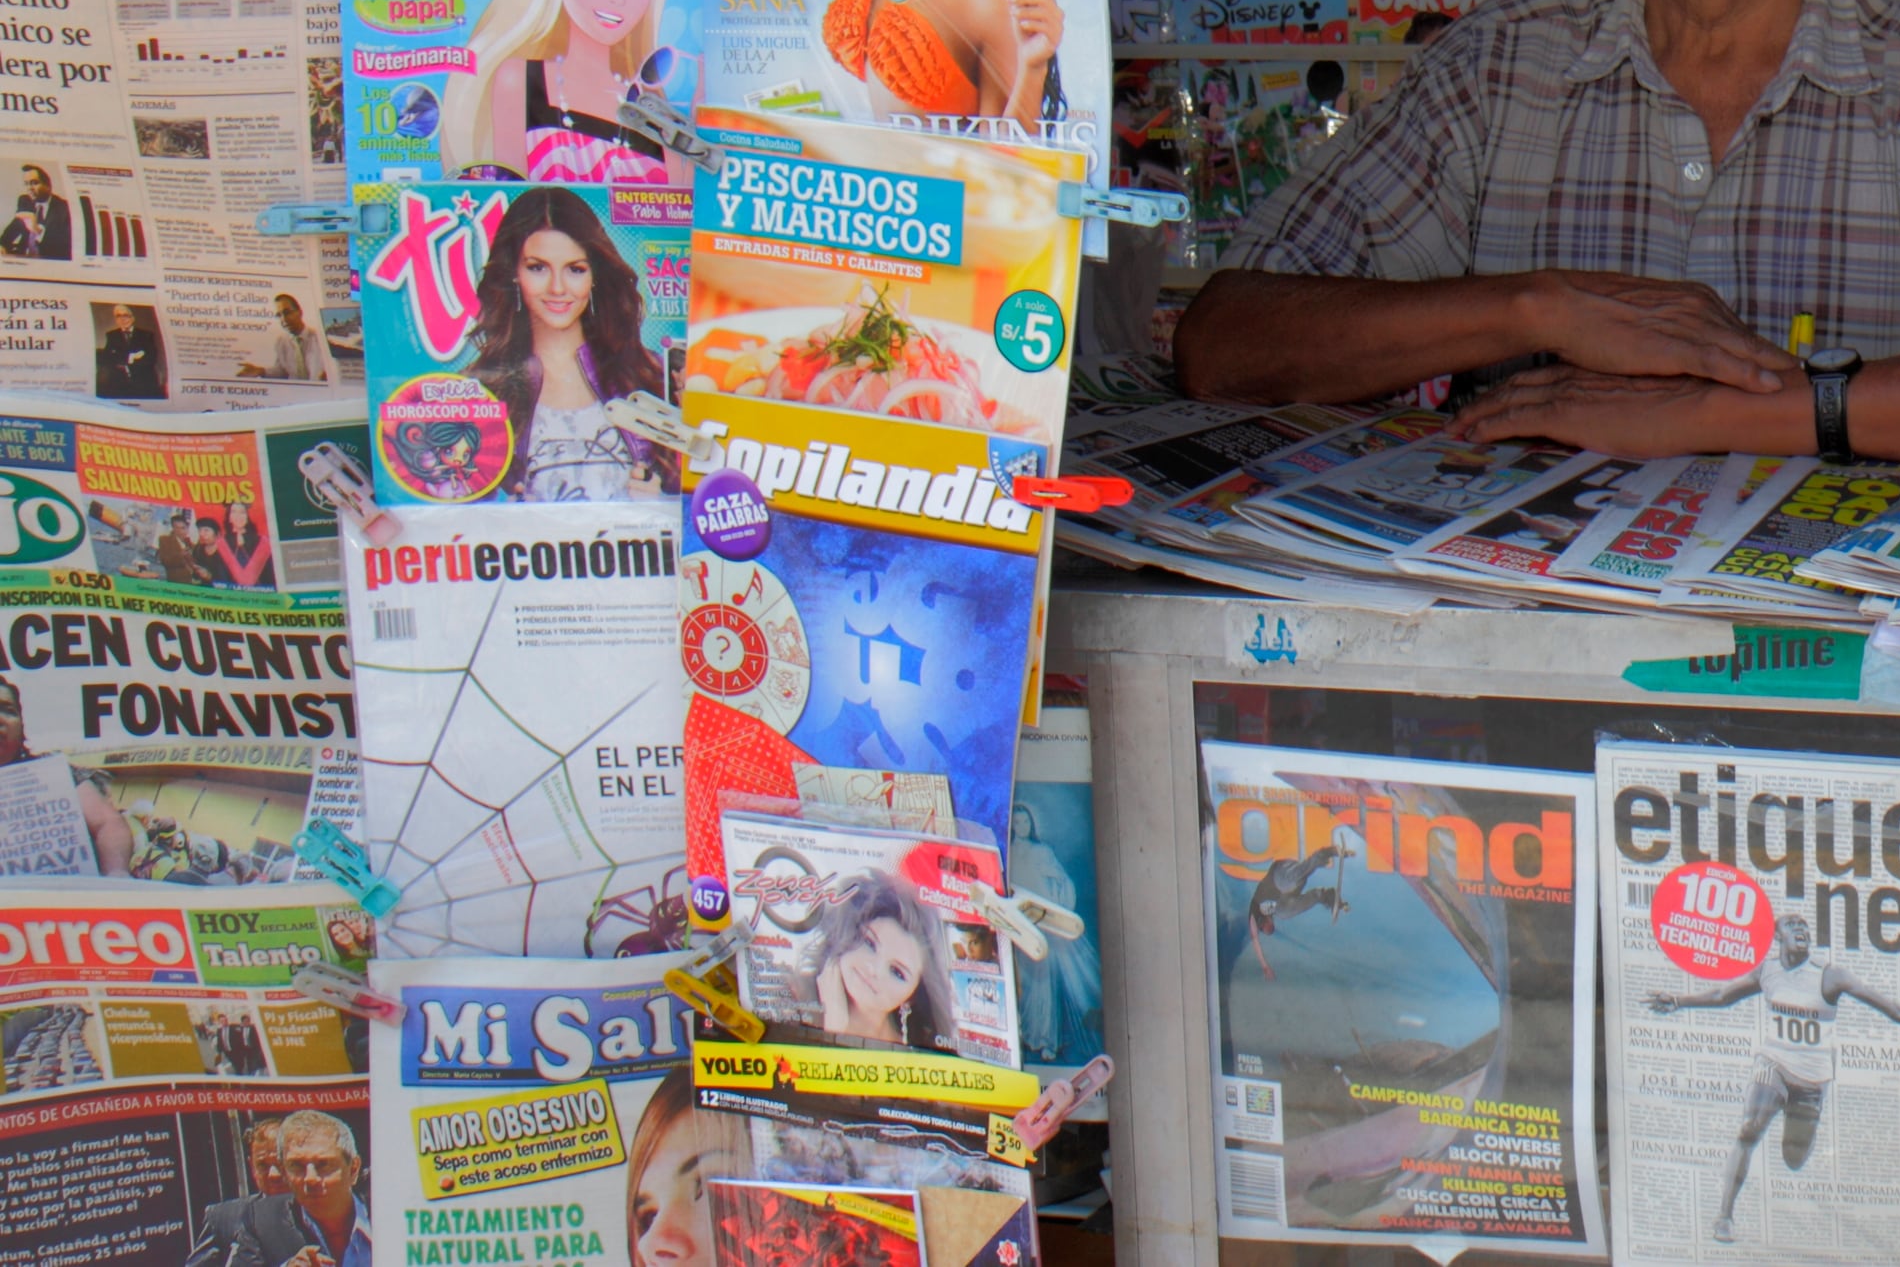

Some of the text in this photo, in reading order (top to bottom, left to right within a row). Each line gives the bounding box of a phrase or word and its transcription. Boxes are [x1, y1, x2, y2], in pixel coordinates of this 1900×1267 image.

[60, 62, 112, 87] por
[387, 402, 502, 420] HORÓSCOPO 2012
[704, 492, 753, 514] CAZA
[695, 507, 768, 534] PALABRAS
[1216, 796, 1573, 889] grind
[693, 889, 726, 911] 457
[1677, 873, 1756, 925] 100
[194, 913, 260, 934] HOY
[202, 942, 322, 966] Talento
[420, 1000, 512, 1065] Mi
[701, 1057, 767, 1076] YOLEO
[1840, 1044, 1878, 1064] KINA
[799, 1060, 995, 1092] RELATOS POLICIALES
[419, 1089, 606, 1154] AMOR OBSESIVO
[1474, 1133, 1562, 1155] CONVERSE
[1449, 1146, 1562, 1171] BLOCK PARTY
[405, 1204, 584, 1235] TRATAMIENTO
